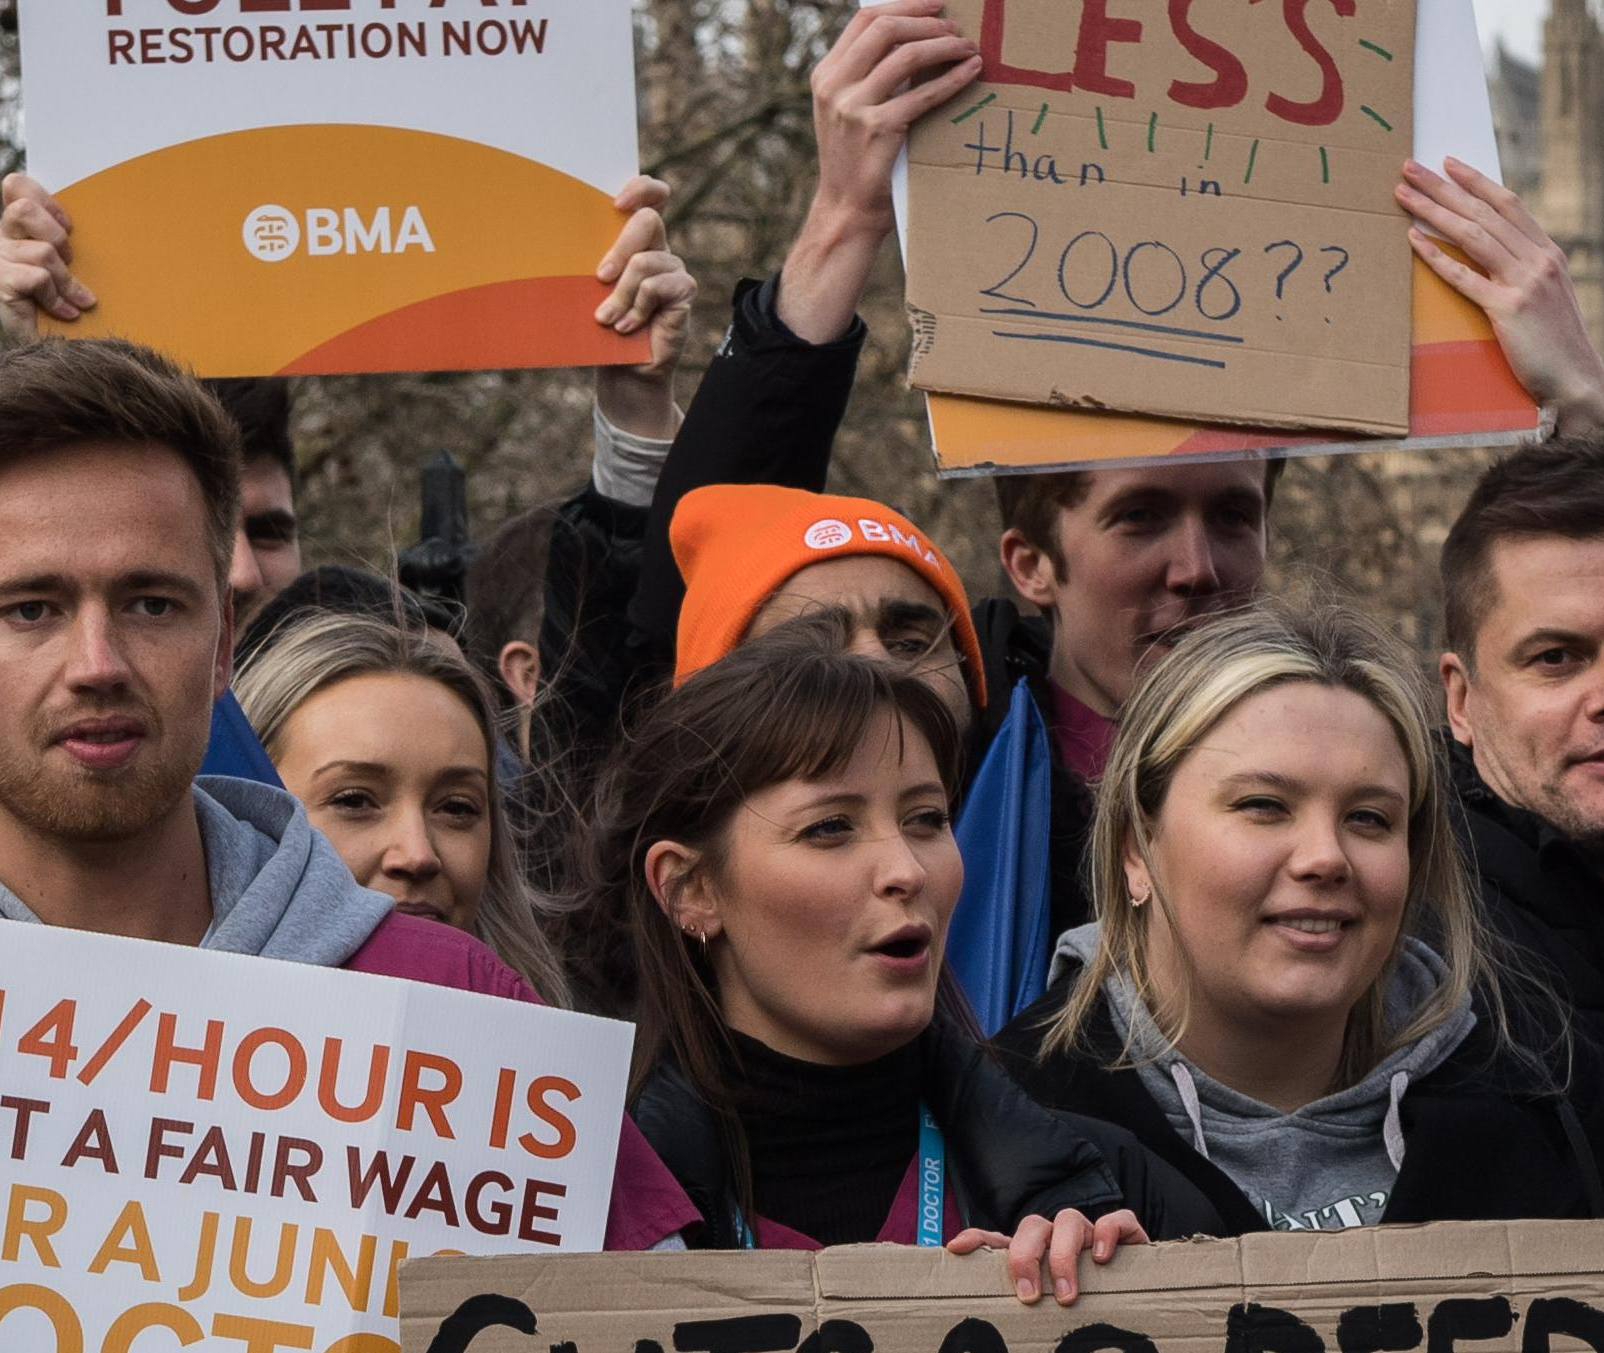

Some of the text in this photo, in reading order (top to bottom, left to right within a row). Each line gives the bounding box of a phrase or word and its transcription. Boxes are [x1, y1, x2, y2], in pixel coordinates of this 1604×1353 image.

[107, 18, 548, 65] RESTORATION NOW
[964, 110, 1222, 197] than in
[306, 205, 436, 257] BMA
[979, 212, 1350, 324] 2008??
[857, 518, 943, 574] BMA
[488, 1067, 582, 1160] IS
[62, 1108, 120, 1175] A
[144, 1118, 324, 1203] FAIR
[346, 1144, 568, 1248] WAGE
[923, 1157, 941, 1233] DOCTOR
[87, 1201, 160, 1284] A
[177, 1211, 470, 1320] JUNI
